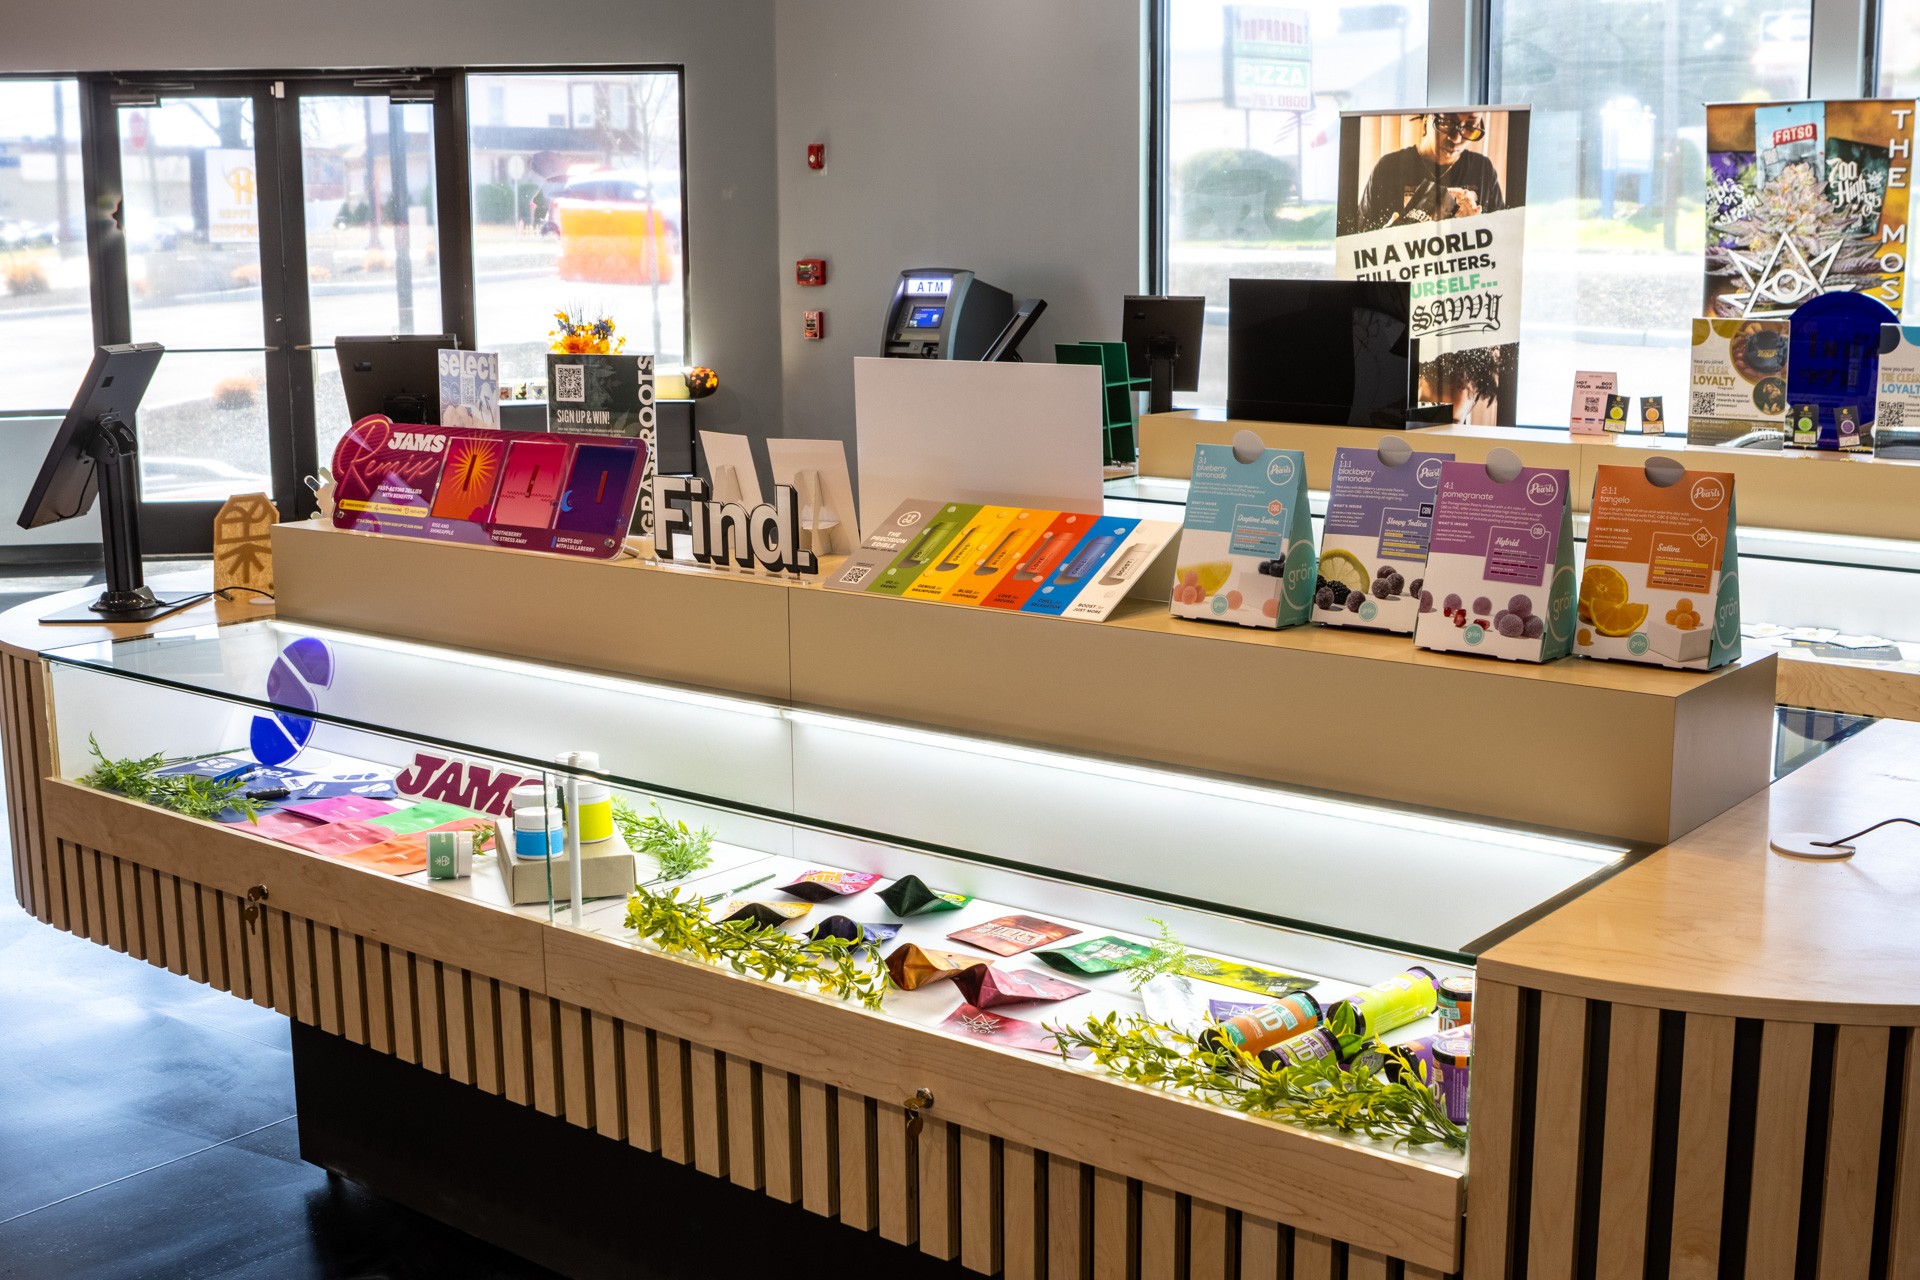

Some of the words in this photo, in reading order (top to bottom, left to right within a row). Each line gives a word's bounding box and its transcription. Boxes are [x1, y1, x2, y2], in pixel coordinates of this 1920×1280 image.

[1240, 64, 1305, 87] PIZZA
[1775, 125, 1813, 143] FATSO
[1888, 109, 1912, 188] THE
[1353, 248, 1377, 270] IN
[1383, 245, 1400, 265] A
[1405, 228, 1493, 260] WORLD
[1399, 266, 1420, 281] OF
[1424, 253, 1496, 277] FILTERS,
[1879, 223, 1906, 303] MOS
[917, 281, 944, 293] ATM
[1411, 273, 1498, 299] URSELF...
[1411, 291, 1502, 332] SAVVY
[440, 350, 498, 381] select
[1693, 375, 1736, 386] LOYALTY
[1881, 383, 1920, 394] LOYALT
[556, 409, 575, 423] SIGN
[576, 410, 586, 423] UP
[586, 411, 592, 423] &
[592, 411, 610, 425] WIN!
[388, 432, 447, 453] JAMS
[637, 355, 655, 537] GRAROOTS
[338, 419, 439, 497] Remix
[1197, 464, 1227, 472] blueberry
[1270, 464, 1291, 475] Pearls
[1339, 468, 1375, 477] blackberry
[1420, 467, 1440, 479] Pearl
[1195, 471, 1227, 479] lemonade
[1444, 482, 1454, 490] 4:1
[1530, 483, 1554, 495] Pearls
[1601, 486, 1617, 494] 2:1:1
[1442, 491, 1494, 501] pomegranate
[1694, 487, 1720, 499] Pearls
[1600, 495, 1630, 505] tangelo
[1421, 507, 1432, 515] CBN
[652, 475, 817, 574] Find.
[1237, 514, 1260, 524] Daytime
[1260, 516, 1279, 525] Sativa
[1386, 517, 1406, 527] Sleepy
[1406, 519, 1428, 528] Indica
[430, 528, 455, 536] SHINEAPPLE
[492, 529, 523, 538] SOOTHEBERRY
[870, 535, 908, 544] PRECISION
[871, 541, 897, 549] EDIBLE
[1495, 537, 1520, 547] Hybrid
[567, 544, 595, 553] LULLABERRY
[1657, 543, 1681, 553] Sativa
[1117, 558, 1134, 577] BOOST!
[1288, 564, 1314, 589] grön
[1214, 600, 1227, 609] grön
[1553, 592, 1575, 619] grön
[1361, 607, 1375, 616] grön
[1718, 598, 1738, 628] grön
[1466, 630, 1481, 640] grön
[1630, 640, 1646, 649] grön
[1439, 1018, 1456, 1032] ID
